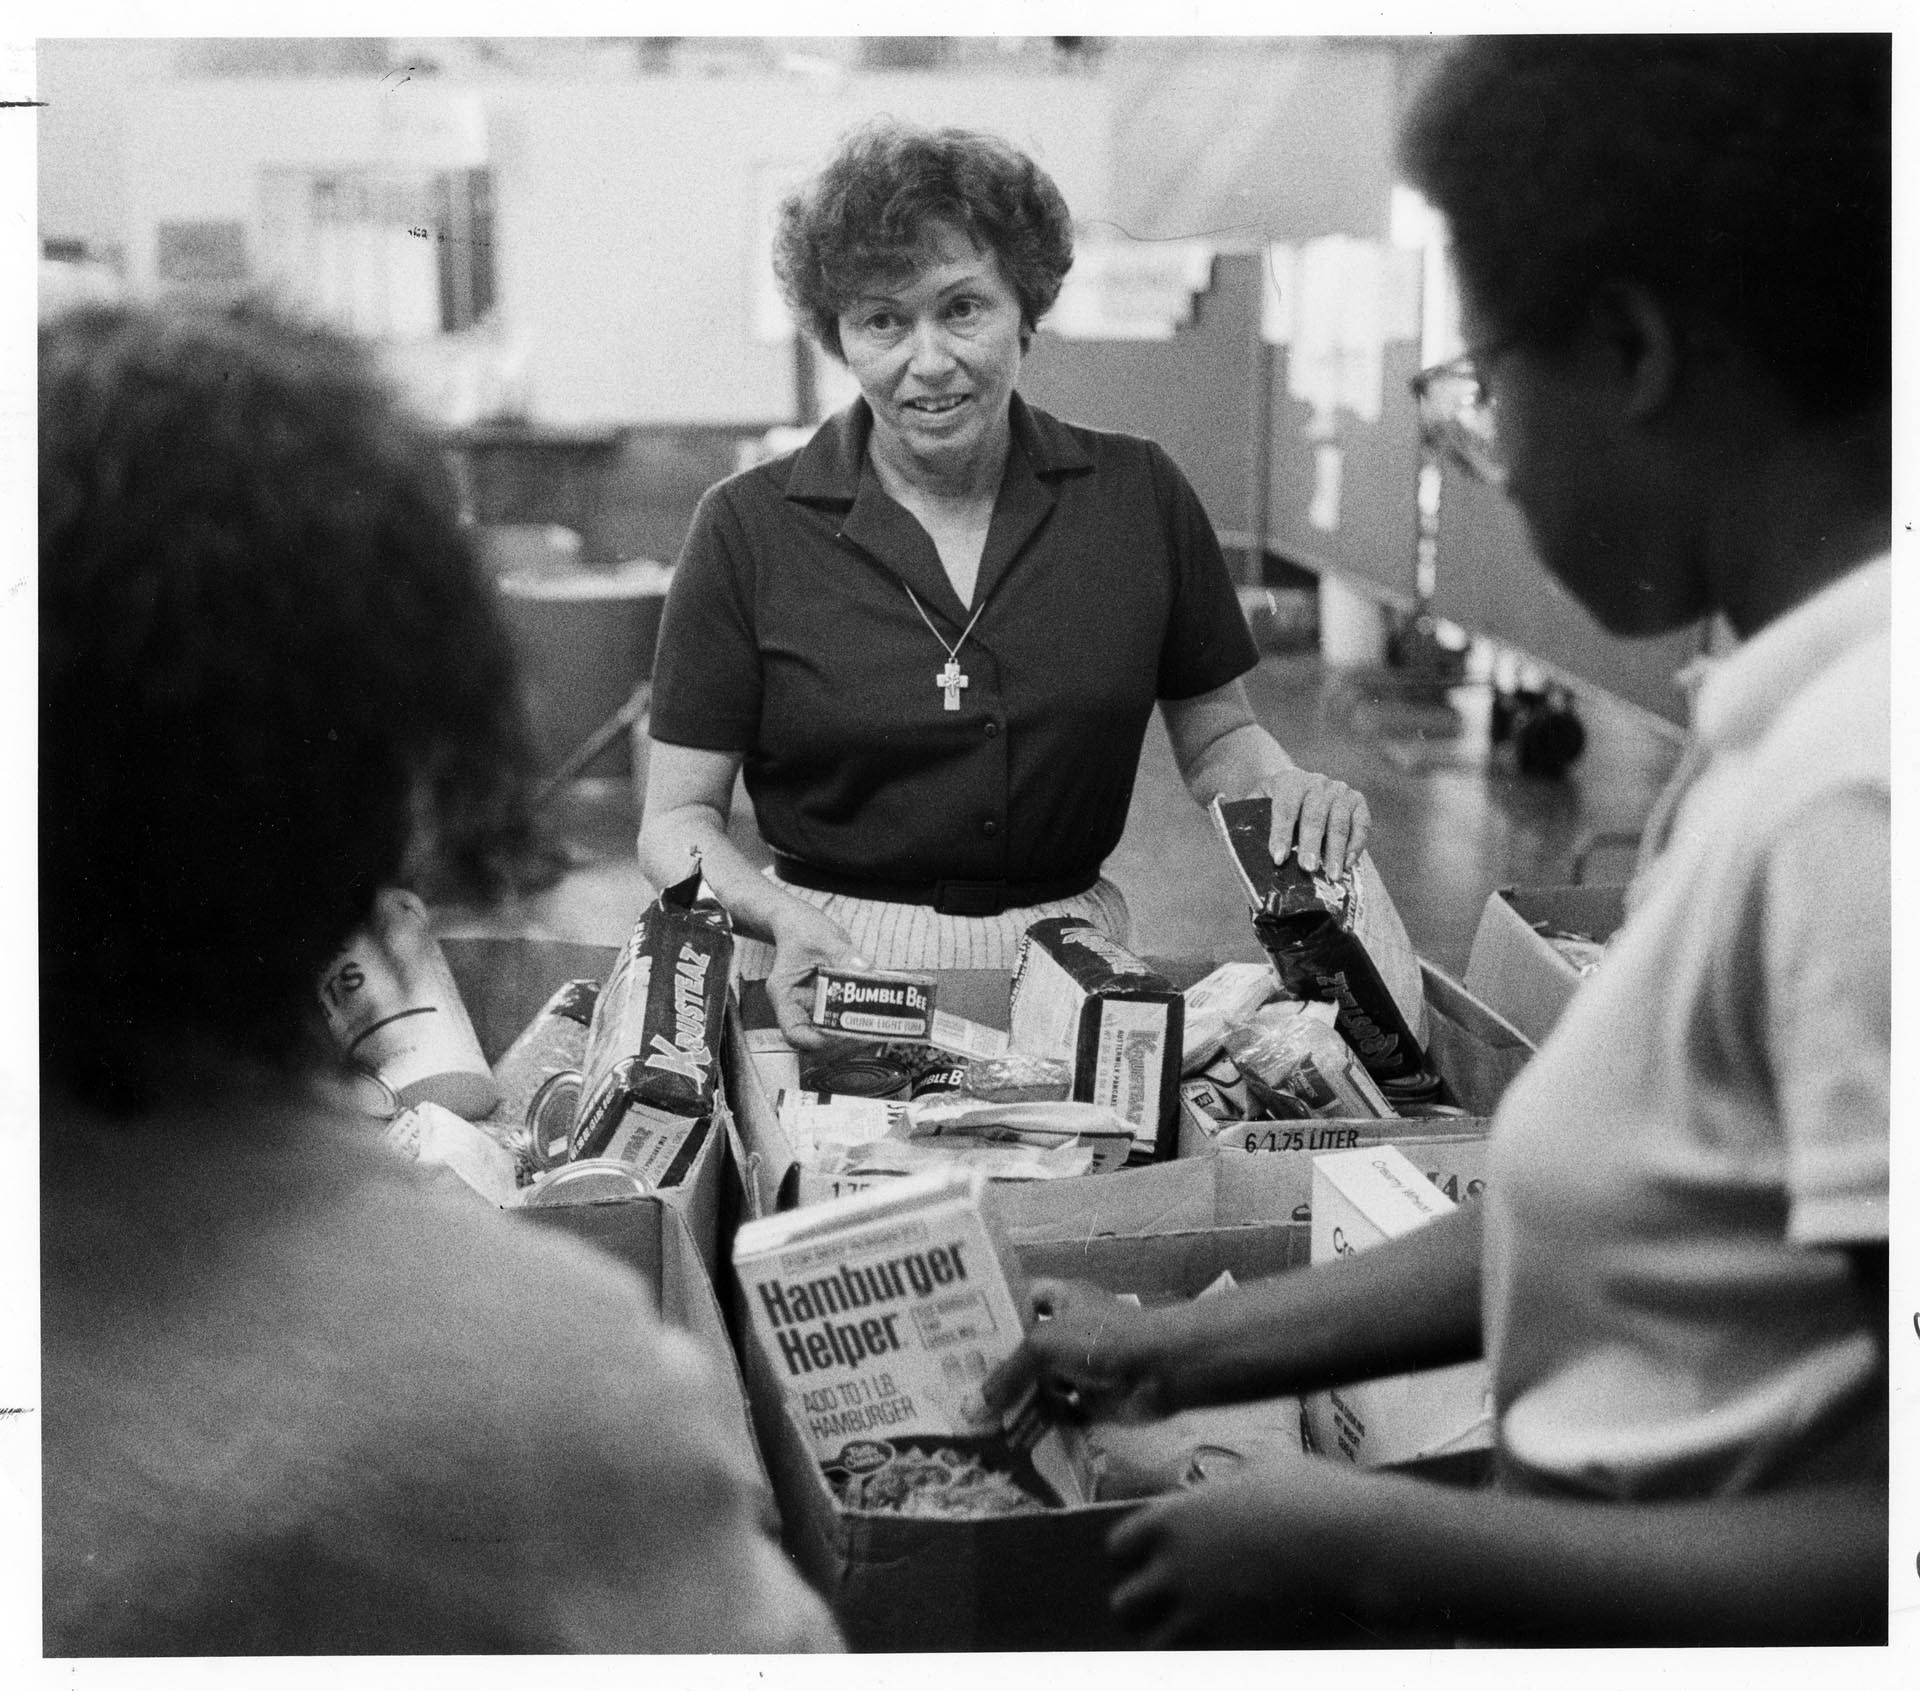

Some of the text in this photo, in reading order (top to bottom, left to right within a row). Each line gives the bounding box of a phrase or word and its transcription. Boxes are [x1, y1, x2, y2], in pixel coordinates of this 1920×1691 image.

[645, 944, 712, 1088] KRUSTEAZ
[843, 980, 928, 1011] BUMBLE BEE
[844, 1015, 874, 1029] CHUNK
[876, 1017, 902, 1030] LIGHT
[1113, 1030, 1124, 1072] BUTTERMILK
[921, 1072, 949, 1086] BLE
[1245, 1129, 1360, 1155] 6/1.75 LITER
[757, 1241, 968, 1328] Hamburger
[777, 1312, 901, 1376] Helper
[803, 1371, 897, 1413] ADD TO 1 LB
[808, 1395, 917, 1439] HAMBURGER
